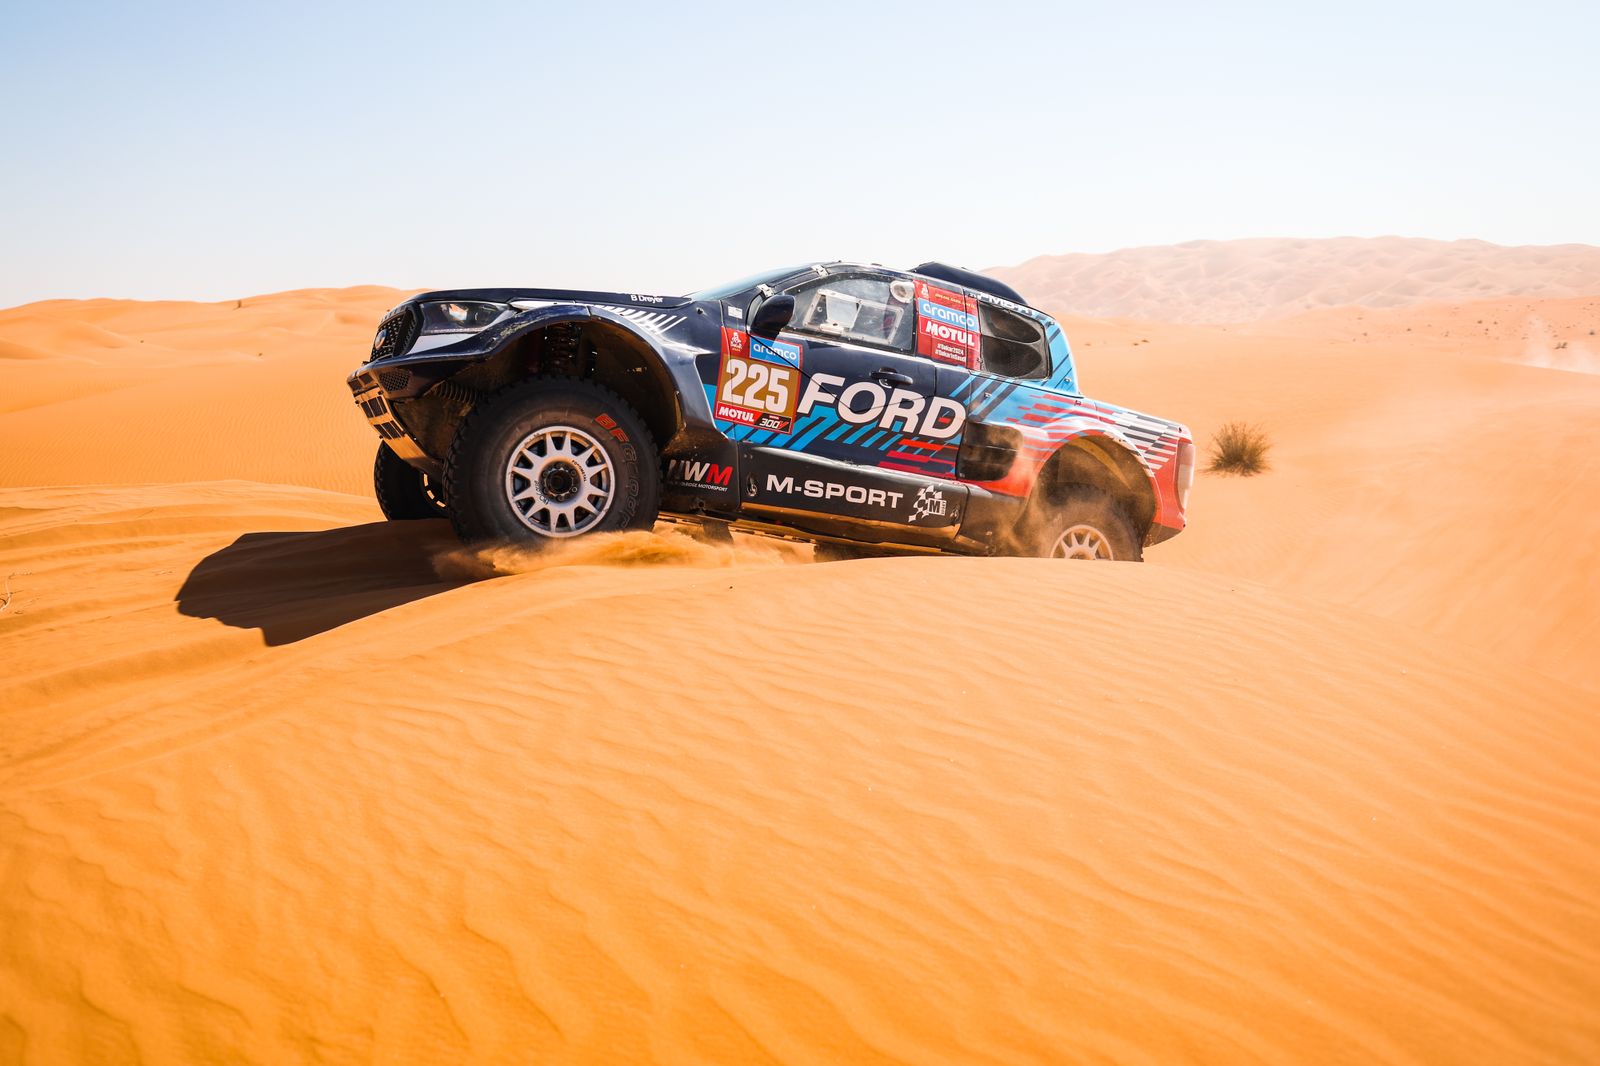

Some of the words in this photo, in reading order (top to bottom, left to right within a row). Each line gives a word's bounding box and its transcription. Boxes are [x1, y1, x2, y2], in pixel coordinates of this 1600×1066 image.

[630, 294, 638, 302] B
[639, 295, 664, 304] Dreyer
[923, 303, 975, 327] aramco
[926, 320, 975, 347] MOTUL
[753, 343, 797, 360] aramco
[722, 358, 789, 413] 225
[718, 406, 755, 422] MOTUL
[797, 372, 967, 439] FORD
[759, 417, 789, 430] 300V
[766, 474, 903, 509] M-SPORT
